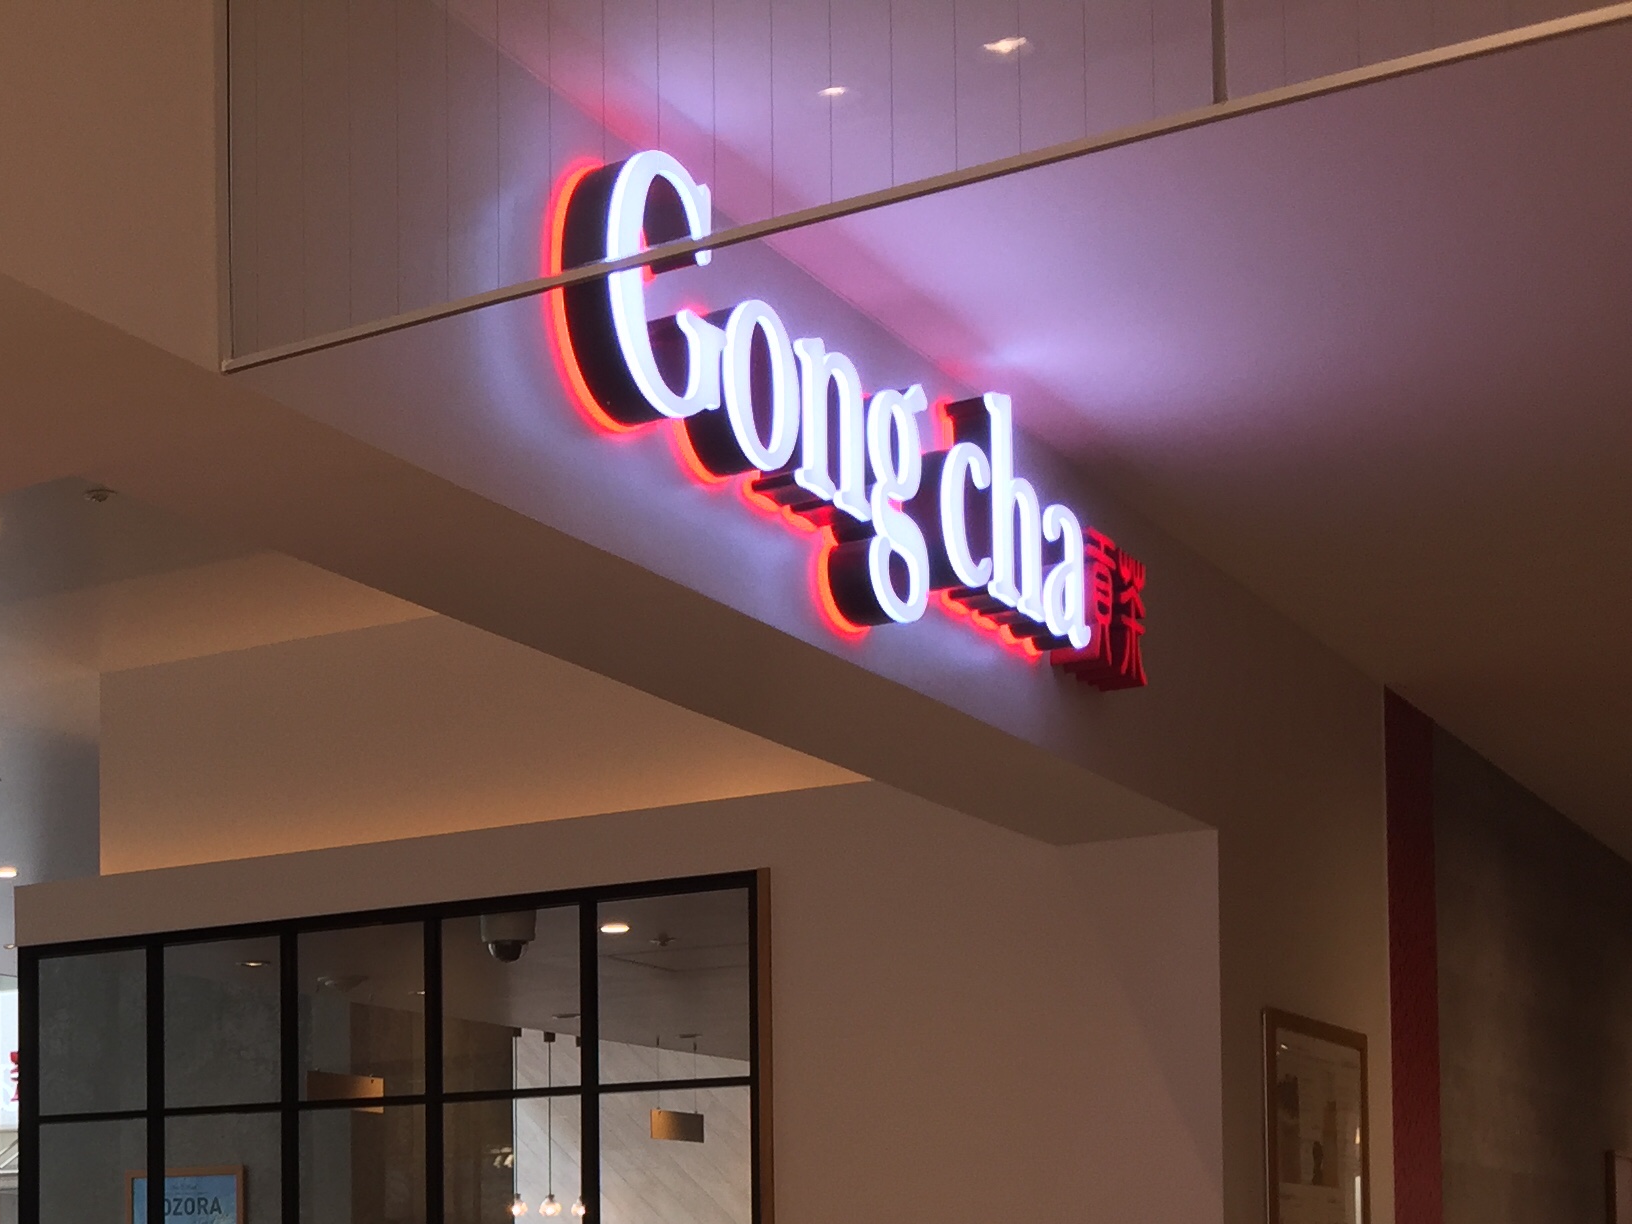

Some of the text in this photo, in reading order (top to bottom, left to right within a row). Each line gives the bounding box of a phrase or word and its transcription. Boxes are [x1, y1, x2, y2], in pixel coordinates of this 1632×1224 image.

[605, 149, 1091, 649] Gong cha
[164, 1196, 222, 1216] OZORA
